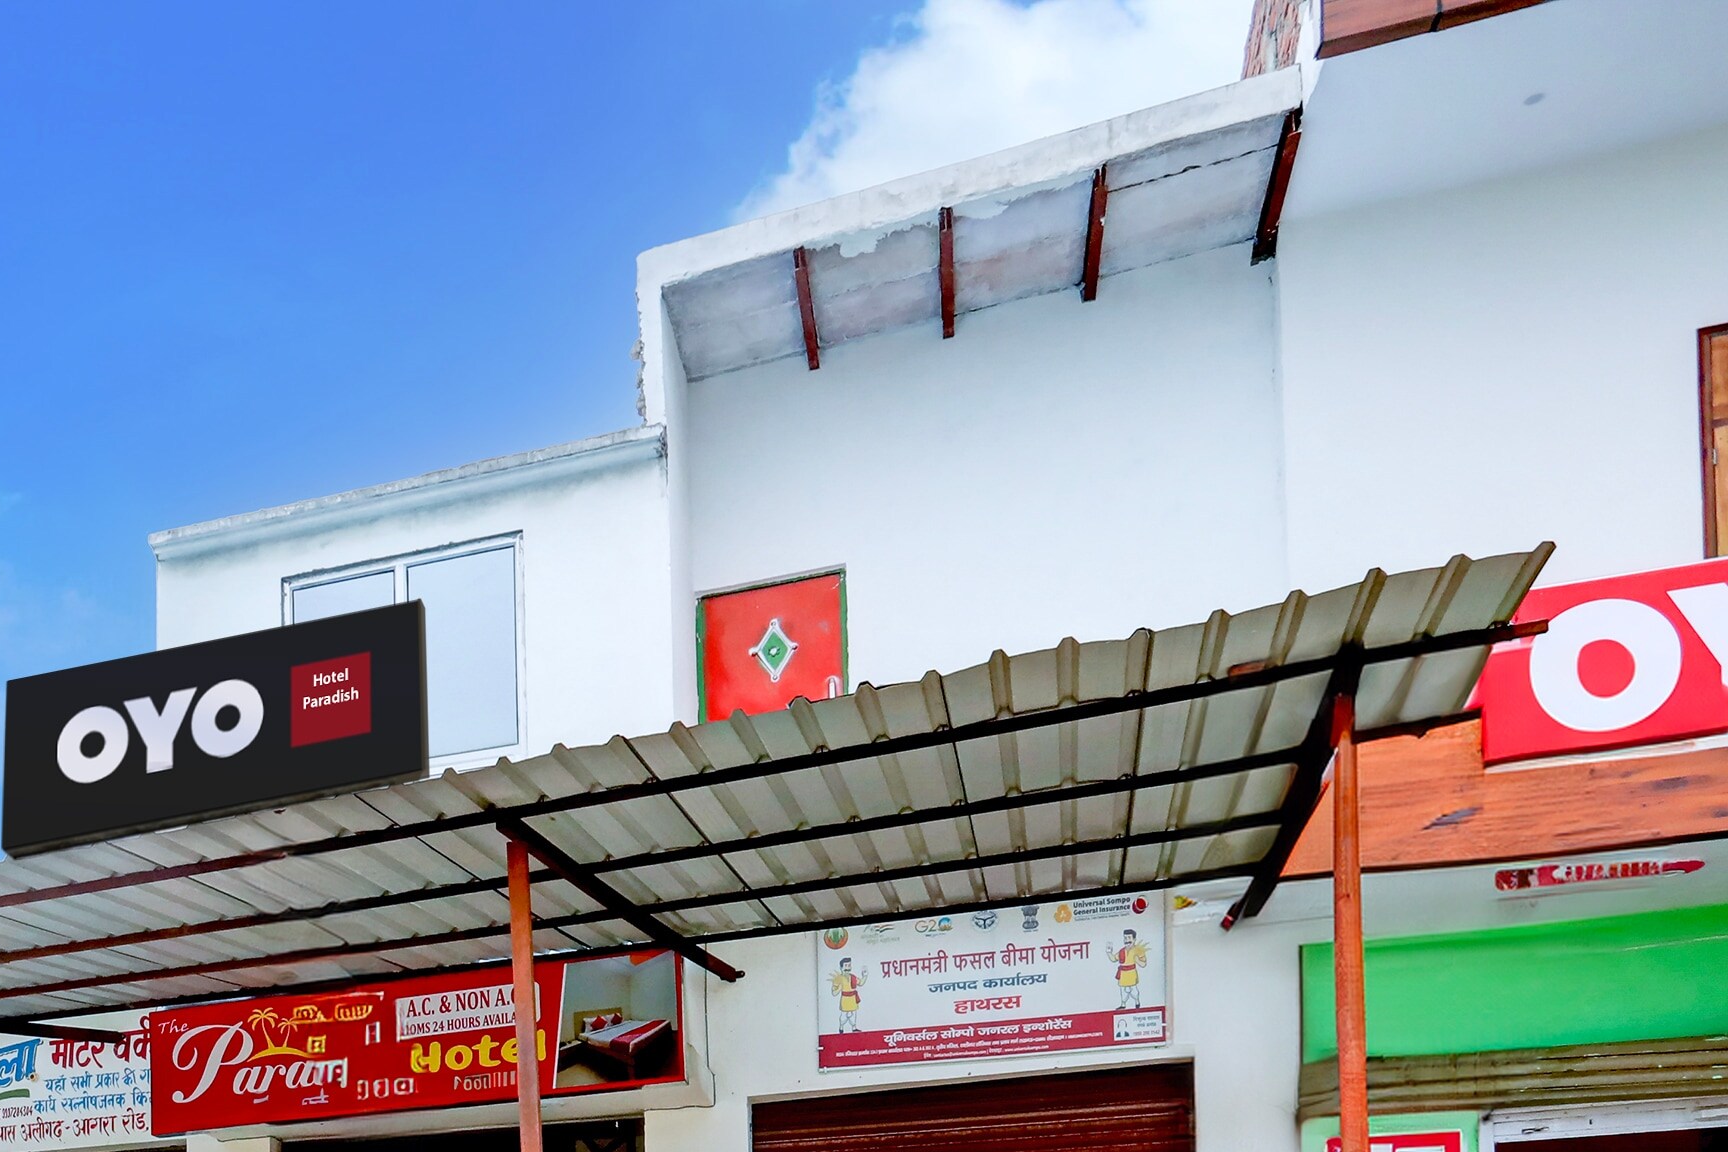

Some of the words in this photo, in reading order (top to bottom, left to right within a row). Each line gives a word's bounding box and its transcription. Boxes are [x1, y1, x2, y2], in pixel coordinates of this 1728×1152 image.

[313, 668, 349, 687] Hotel
[302, 687, 359, 710] Paradish
[57, 679, 264, 784] OYO
[1073, 899, 1106, 908] Universal
[1106, 897, 1131, 906] Sompo
[1073, 907, 1098, 916] General
[1099, 904, 1131, 913] Insurance
[880, 950, 949, 979] प्रधानमंत्री
[952, 950, 996, 971] फसल
[1000, 943, 1036, 967] बीमा
[1041, 938, 1090, 963] योजना
[928, 979, 979, 994] जनपद
[983, 972, 1048, 989] कार्यालय
[407, 998, 435, 1018] A.C.
[439, 995, 452, 1014] &
[456, 989, 491, 1012] NON
[954, 995, 1022, 1014] हाथरस
[158, 1019, 189, 1034] The
[433, 1019, 445, 1032] 24
[447, 1015, 481, 1031] HOURS
[482, 1011, 517, 1027] AVAILA
[978, 1024, 1019, 1036] जनरल
[71, 1071, 93, 1091] सभी
[95, 1072, 120, 1088] प्रकार
[123, 1068, 136, 1085] की
